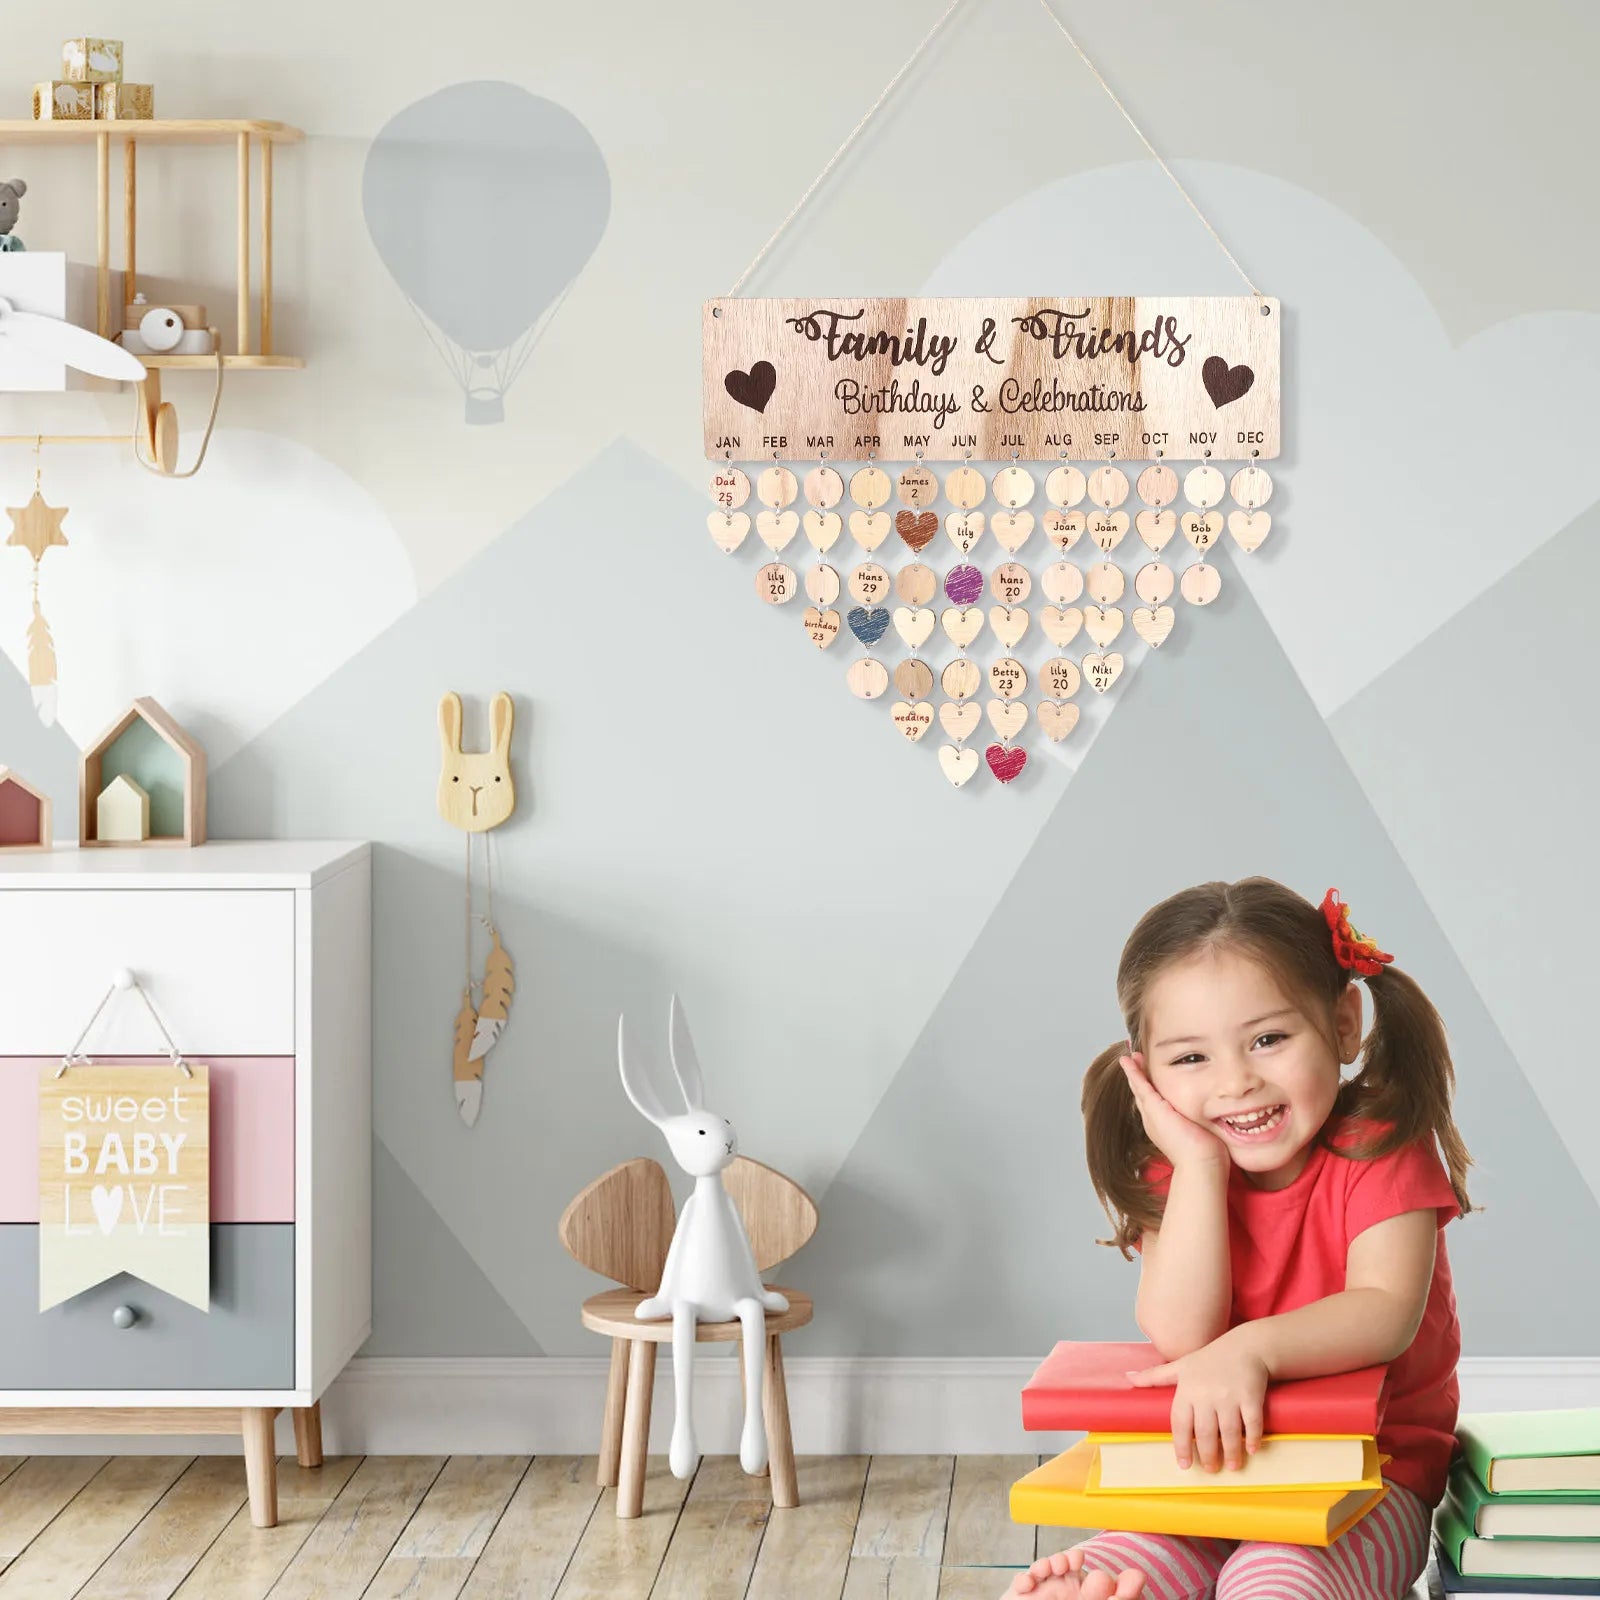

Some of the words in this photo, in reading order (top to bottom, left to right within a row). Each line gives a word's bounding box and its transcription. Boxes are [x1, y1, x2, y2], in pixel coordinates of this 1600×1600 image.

[786, 309, 958, 376] Family
[975, 317, 1005, 365] &
[1012, 308, 1192, 367] Friends
[834, 379, 962, 430] Birthdays
[971, 384, 991, 412] &
[998, 378, 1147, 414] Celebrations
[716, 436, 741, 448] JAN
[763, 436, 788, 448] FEB
[806, 436, 834, 448] MAR
[855, 436, 881, 447] APR
[904, 435, 930, 447] MAY
[952, 435, 977, 447] JUN
[1001, 435, 1025, 447] JUL
[1045, 434, 1072, 446] AUG
[1095, 433, 1119, 446] SEP
[1142, 433, 1169, 445] OCT
[1189, 433, 1217, 445] NOV
[1238, 432, 1264, 444] DEC
[716, 477, 735, 486] Dad
[900, 477, 929, 486] James
[718, 492, 733, 502] 25
[911, 489, 918, 498] 2
[1053, 522, 1076, 531] Joan
[1095, 522, 1118, 532] Joan
[1191, 524, 1211, 532] Bob
[963, 540, 969, 549] 6
[1062, 537, 1068, 547] 9
[1195, 535, 1208, 544] 13
[859, 572, 882, 581] Hans
[1000, 574, 1024, 584] hans
[770, 585, 785, 595] 20
[863, 583, 877, 593] 29
[1006, 587, 1020, 596] 20
[804, 620, 837, 632] birthday
[812, 633, 824, 641] 23
[993, 667, 1019, 679] Betty
[999, 679, 1013, 689] 23
[1053, 678, 1068, 689] 20
[1095, 677, 1107, 687] 21
[895, 713, 929, 723] wedding
[906, 726, 918, 735] 29
[61, 1086, 189, 1123] sweet
[64, 1132, 187, 1175] BABY
